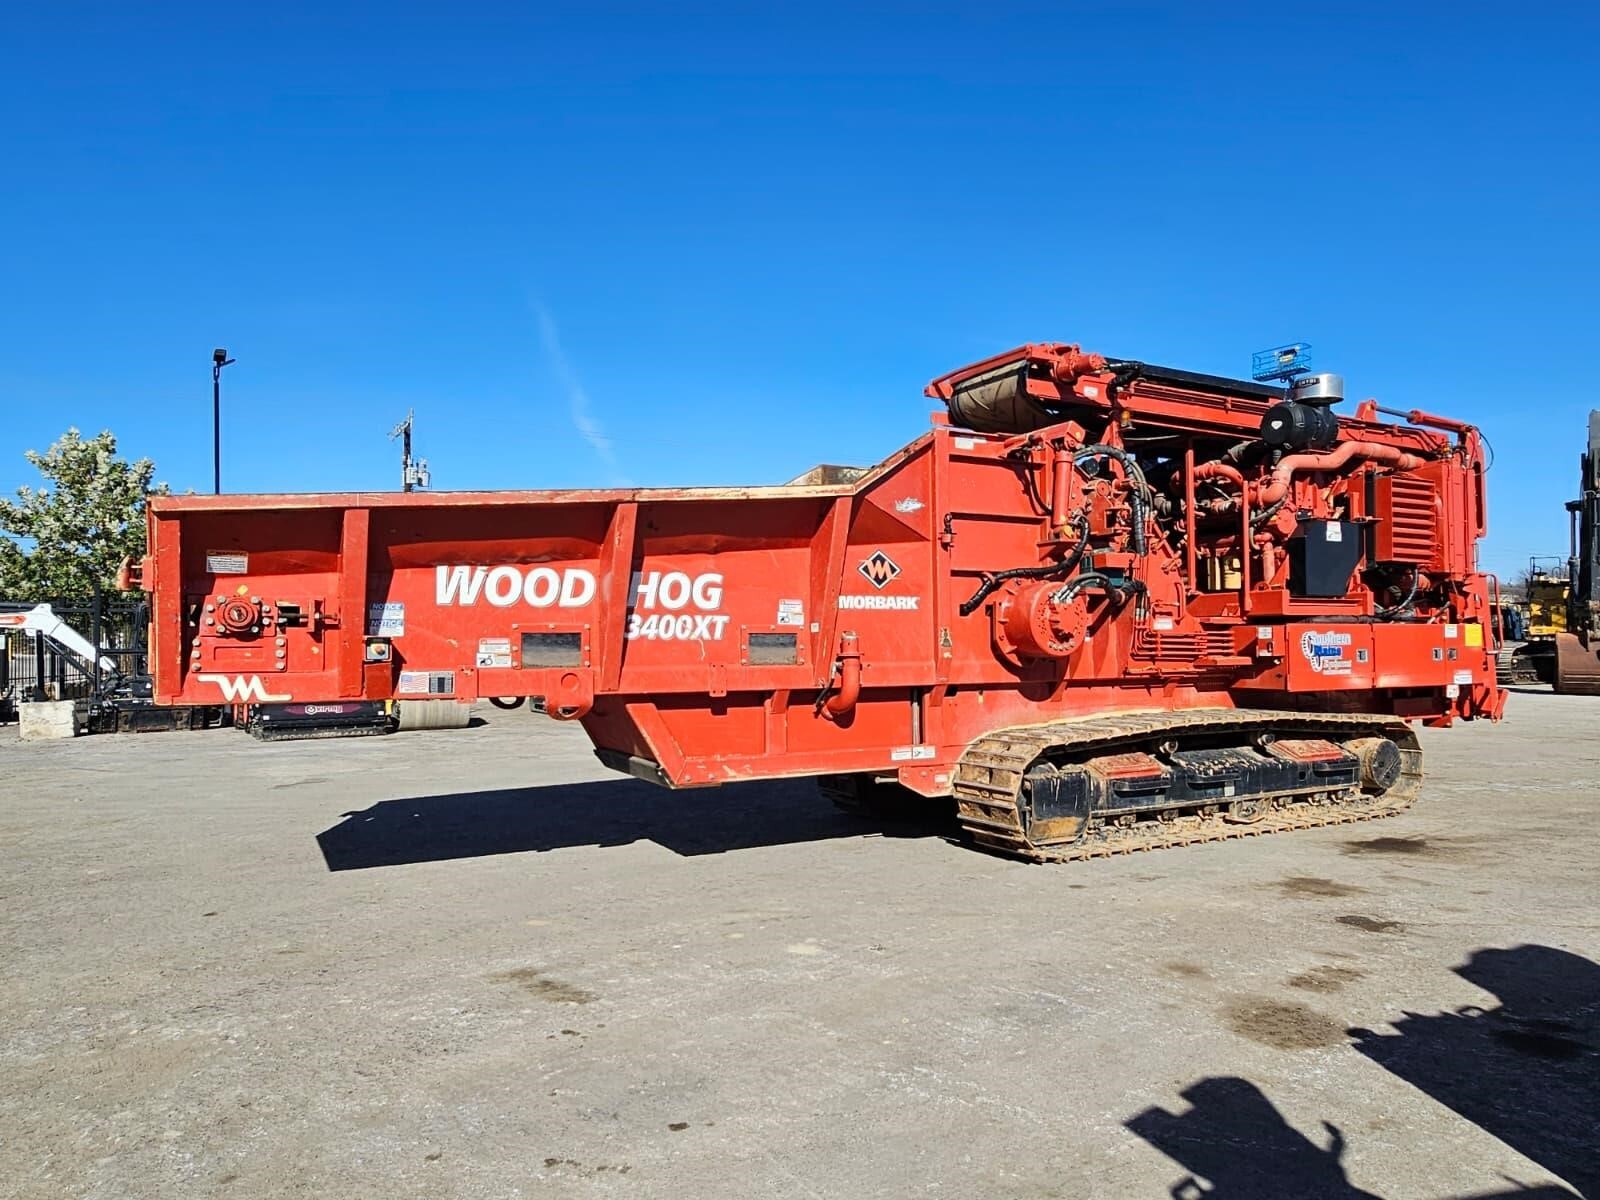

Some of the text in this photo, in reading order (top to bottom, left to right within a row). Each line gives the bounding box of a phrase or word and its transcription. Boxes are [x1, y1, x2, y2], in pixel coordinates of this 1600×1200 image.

[435, 564, 724, 611] WOOD HOG
[838, 595, 920, 611] MORBARK
[624, 614, 730, 641] 3400XT
